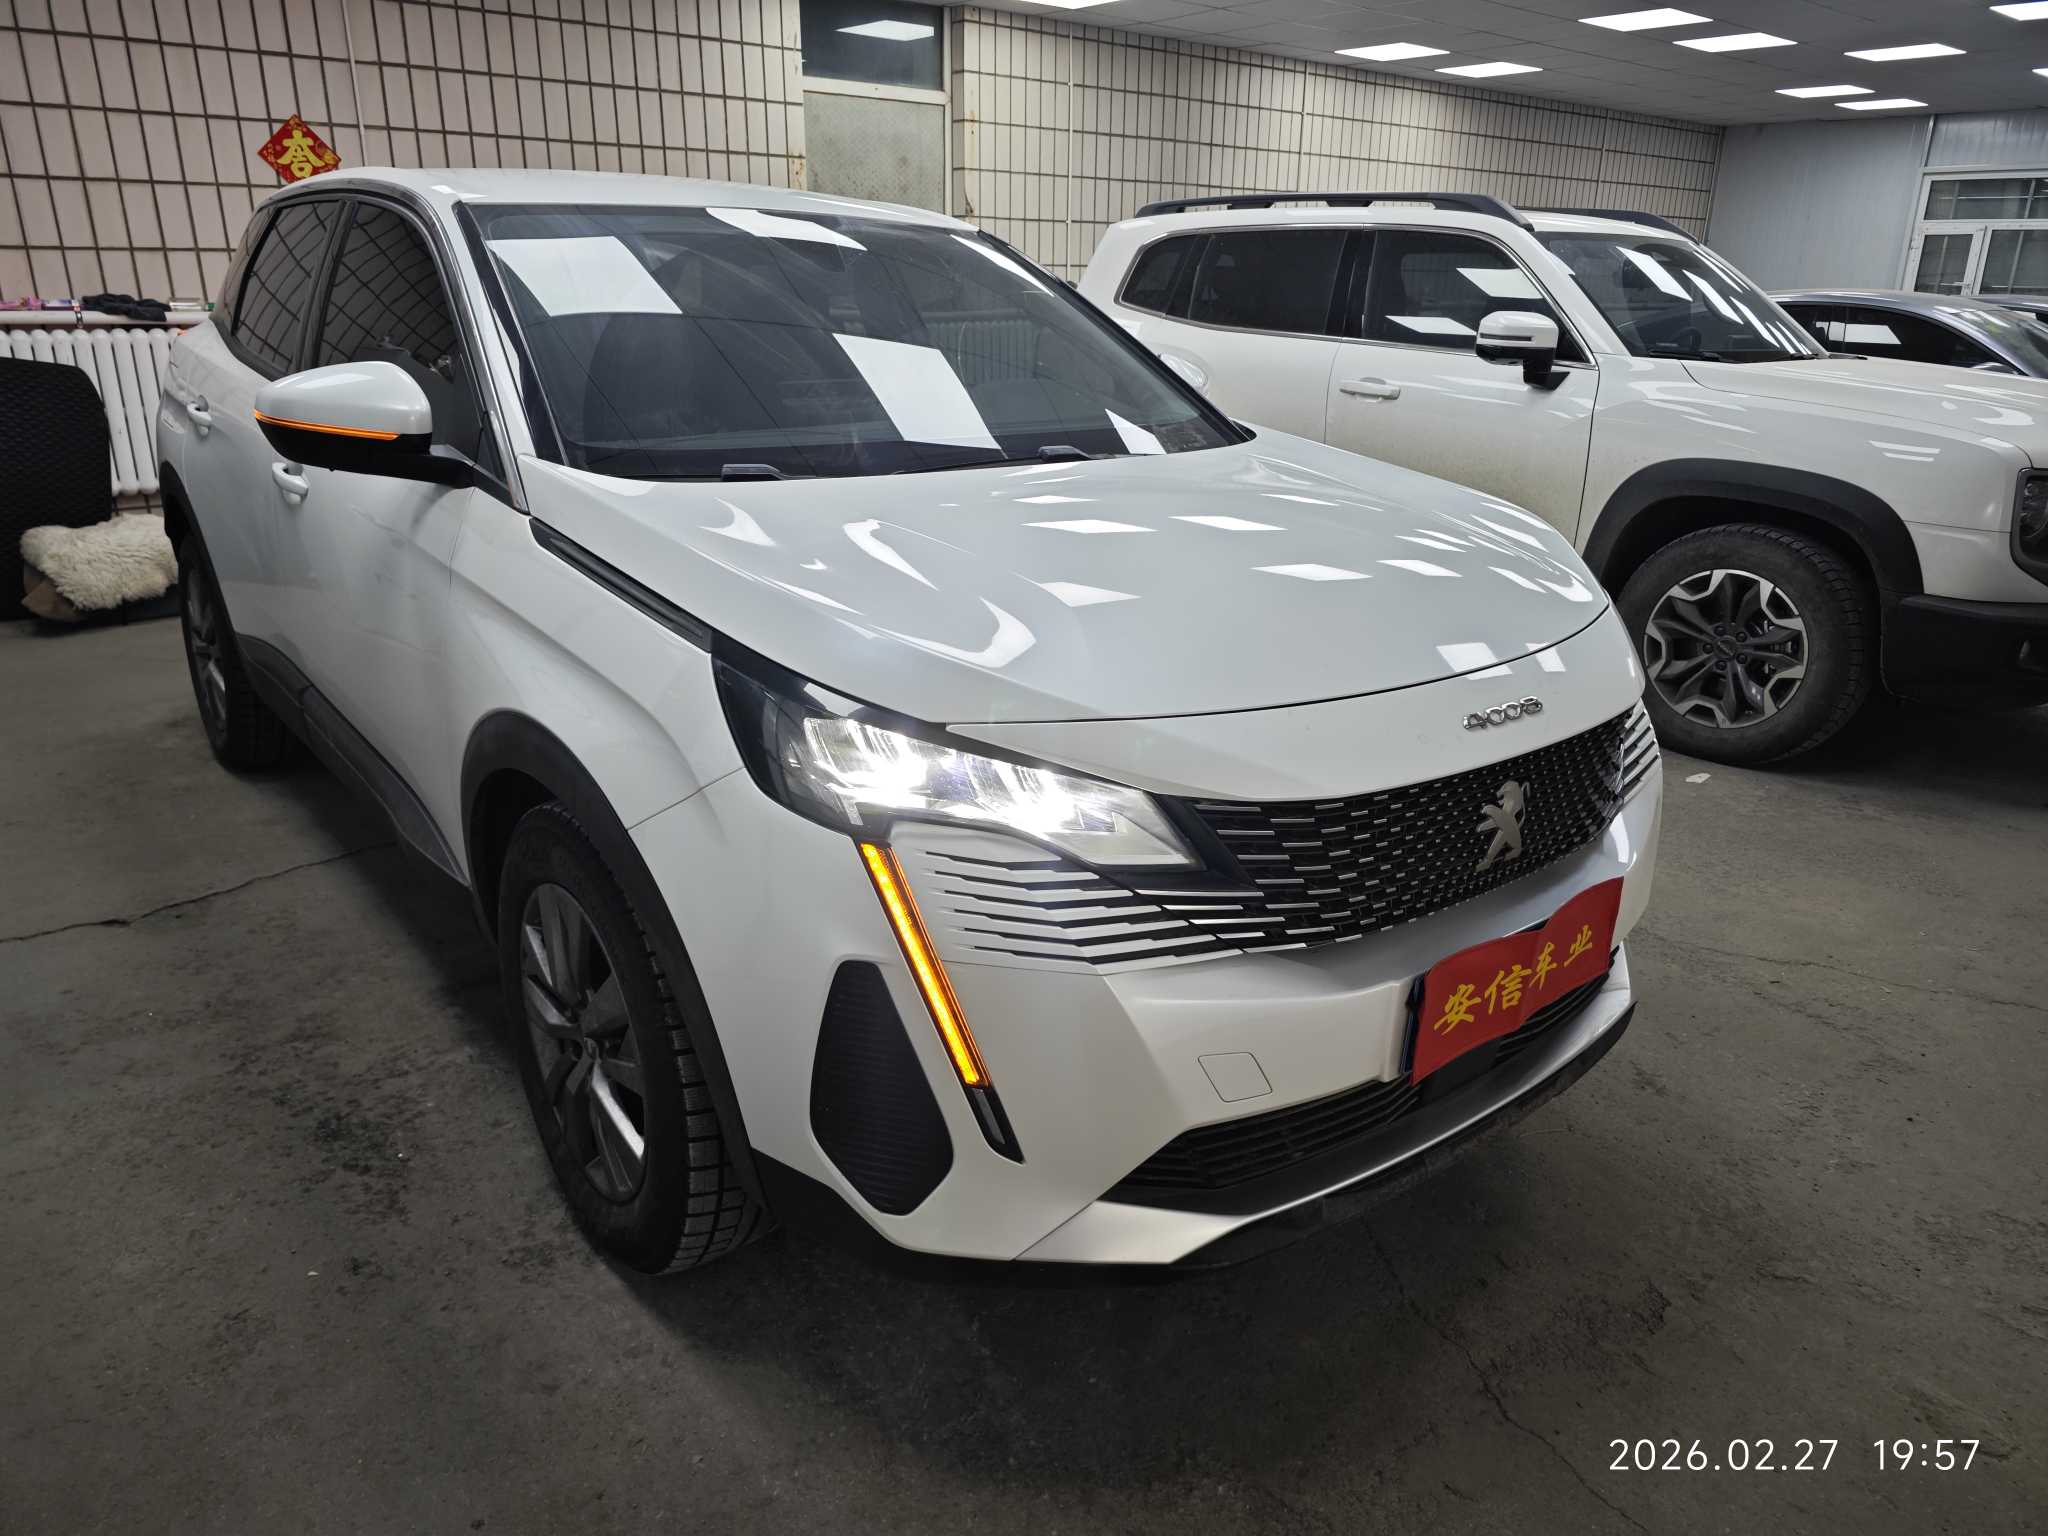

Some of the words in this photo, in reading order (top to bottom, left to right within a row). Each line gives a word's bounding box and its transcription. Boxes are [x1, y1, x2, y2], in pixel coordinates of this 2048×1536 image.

[1463, 695, 1544, 730] 4008
[1433, 924, 1593, 1036] 安信车业
